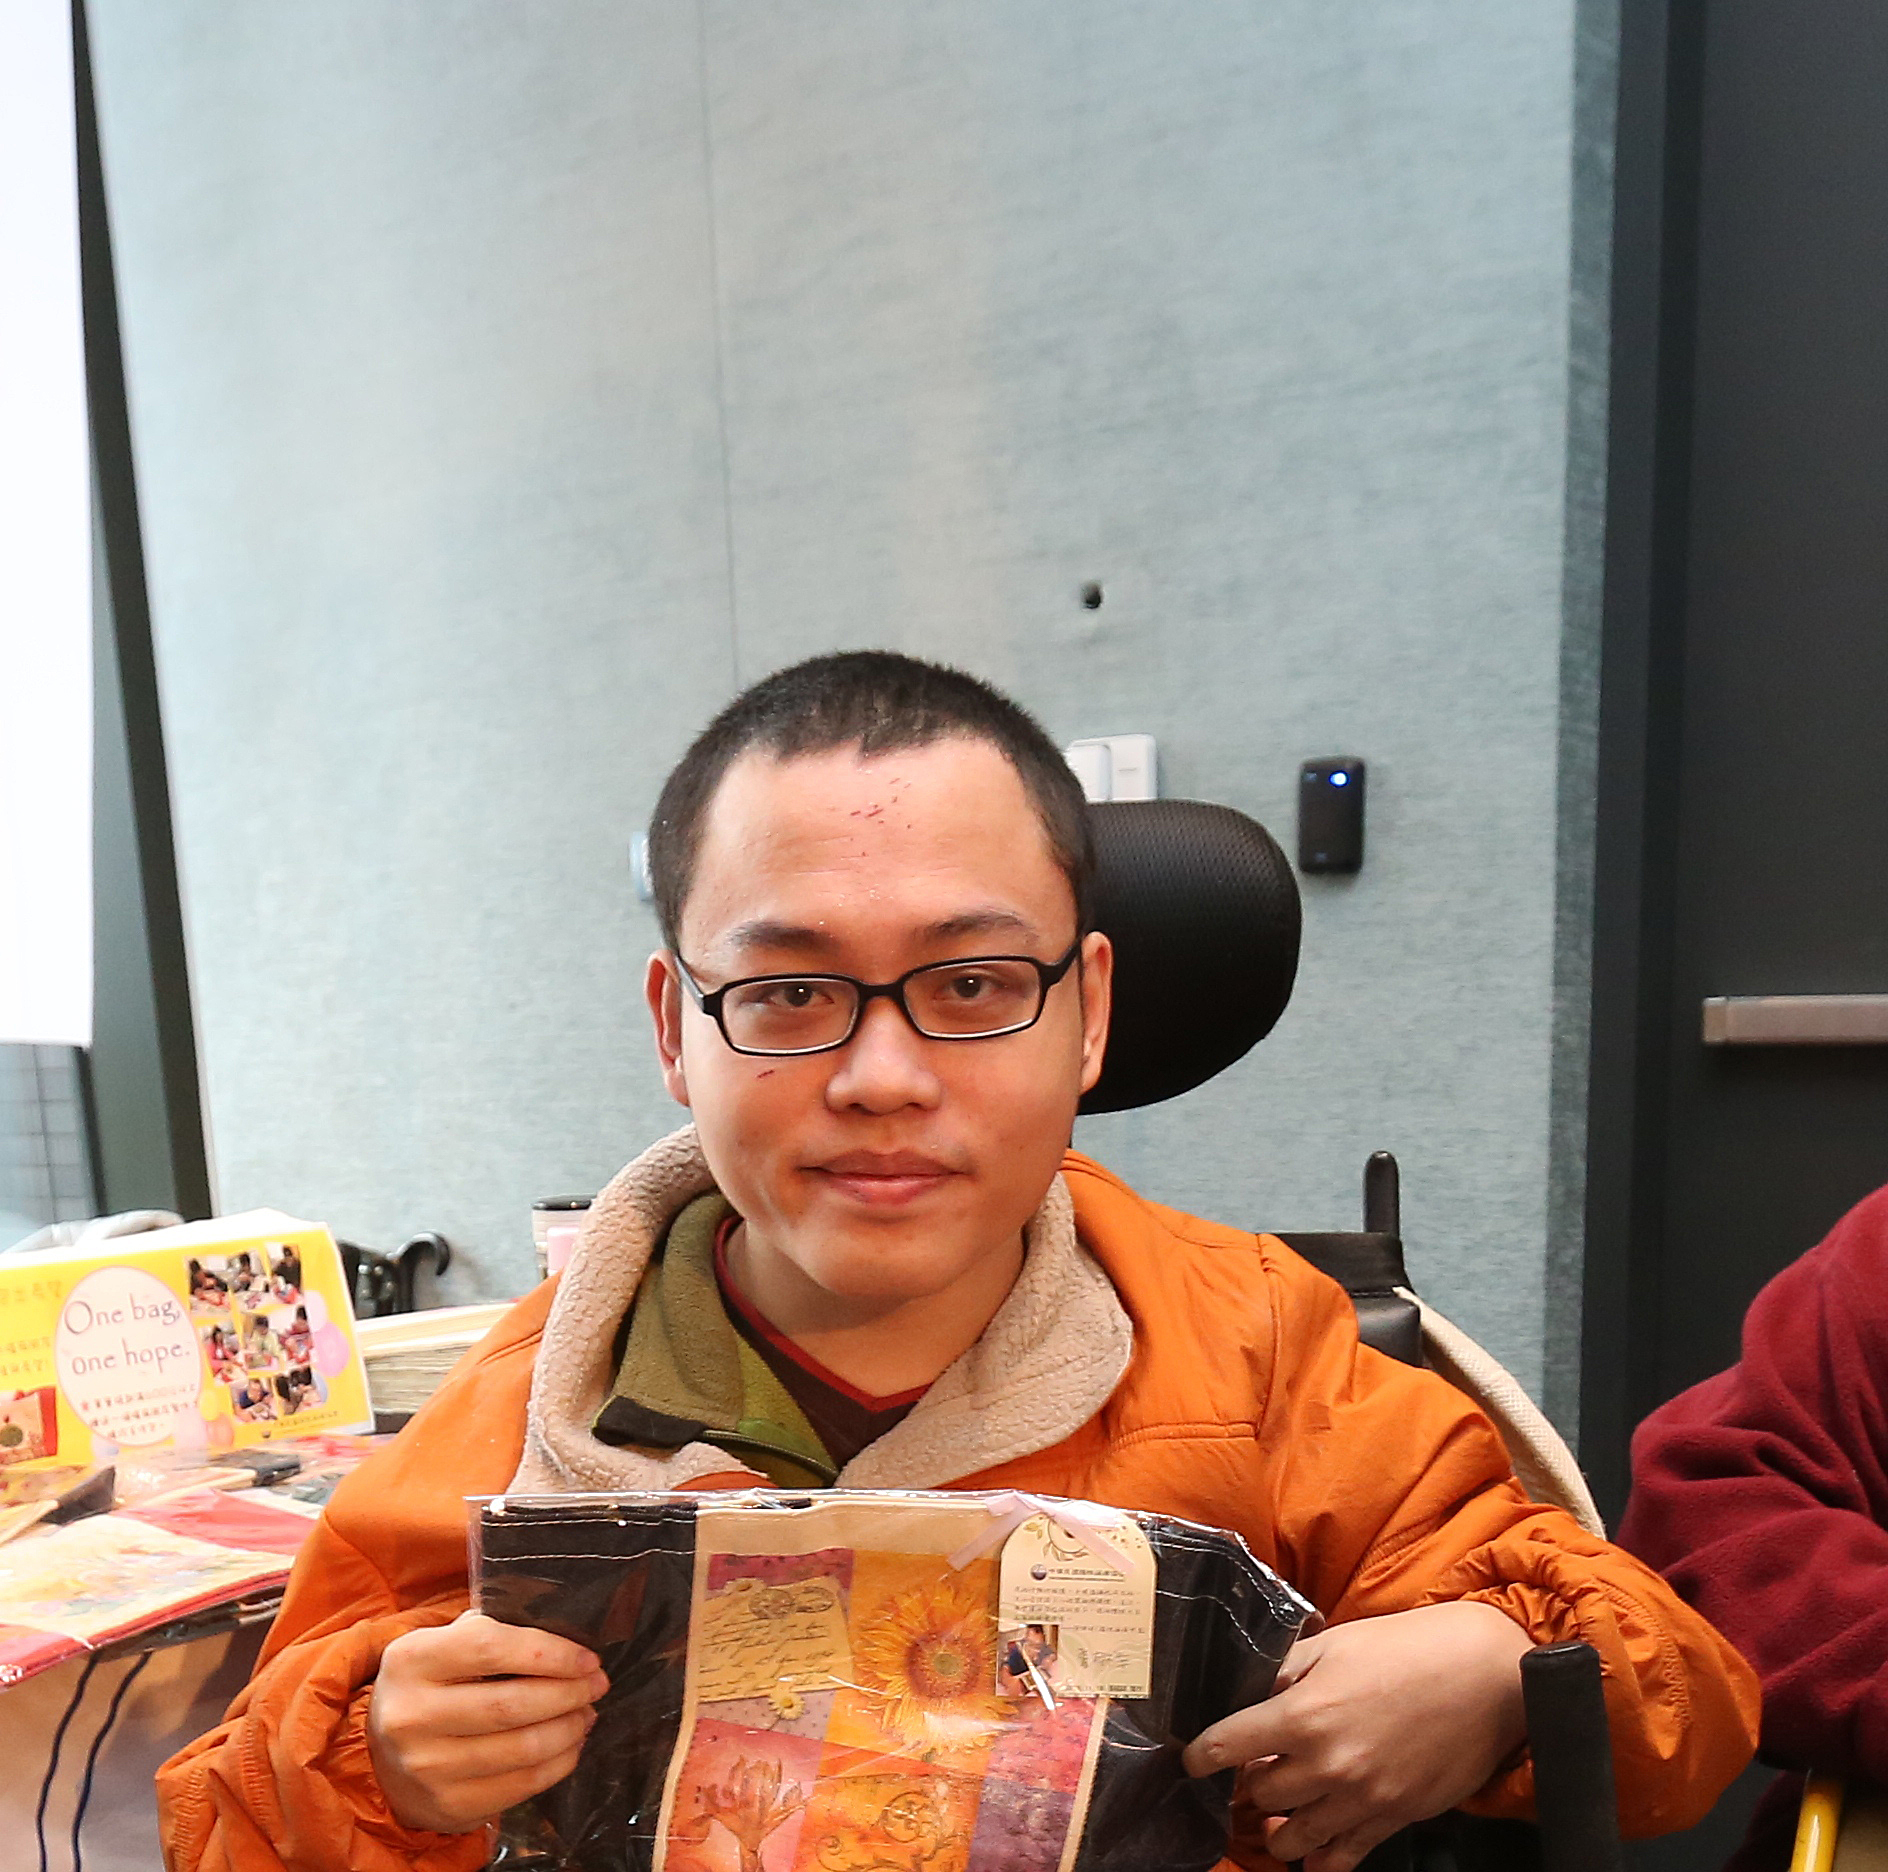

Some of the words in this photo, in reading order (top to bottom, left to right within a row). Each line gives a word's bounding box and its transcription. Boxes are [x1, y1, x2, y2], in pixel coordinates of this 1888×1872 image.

[63, 1299, 125, 1337] One
[71, 1351, 116, 1378] one
[122, 1334, 191, 1378] hope.
